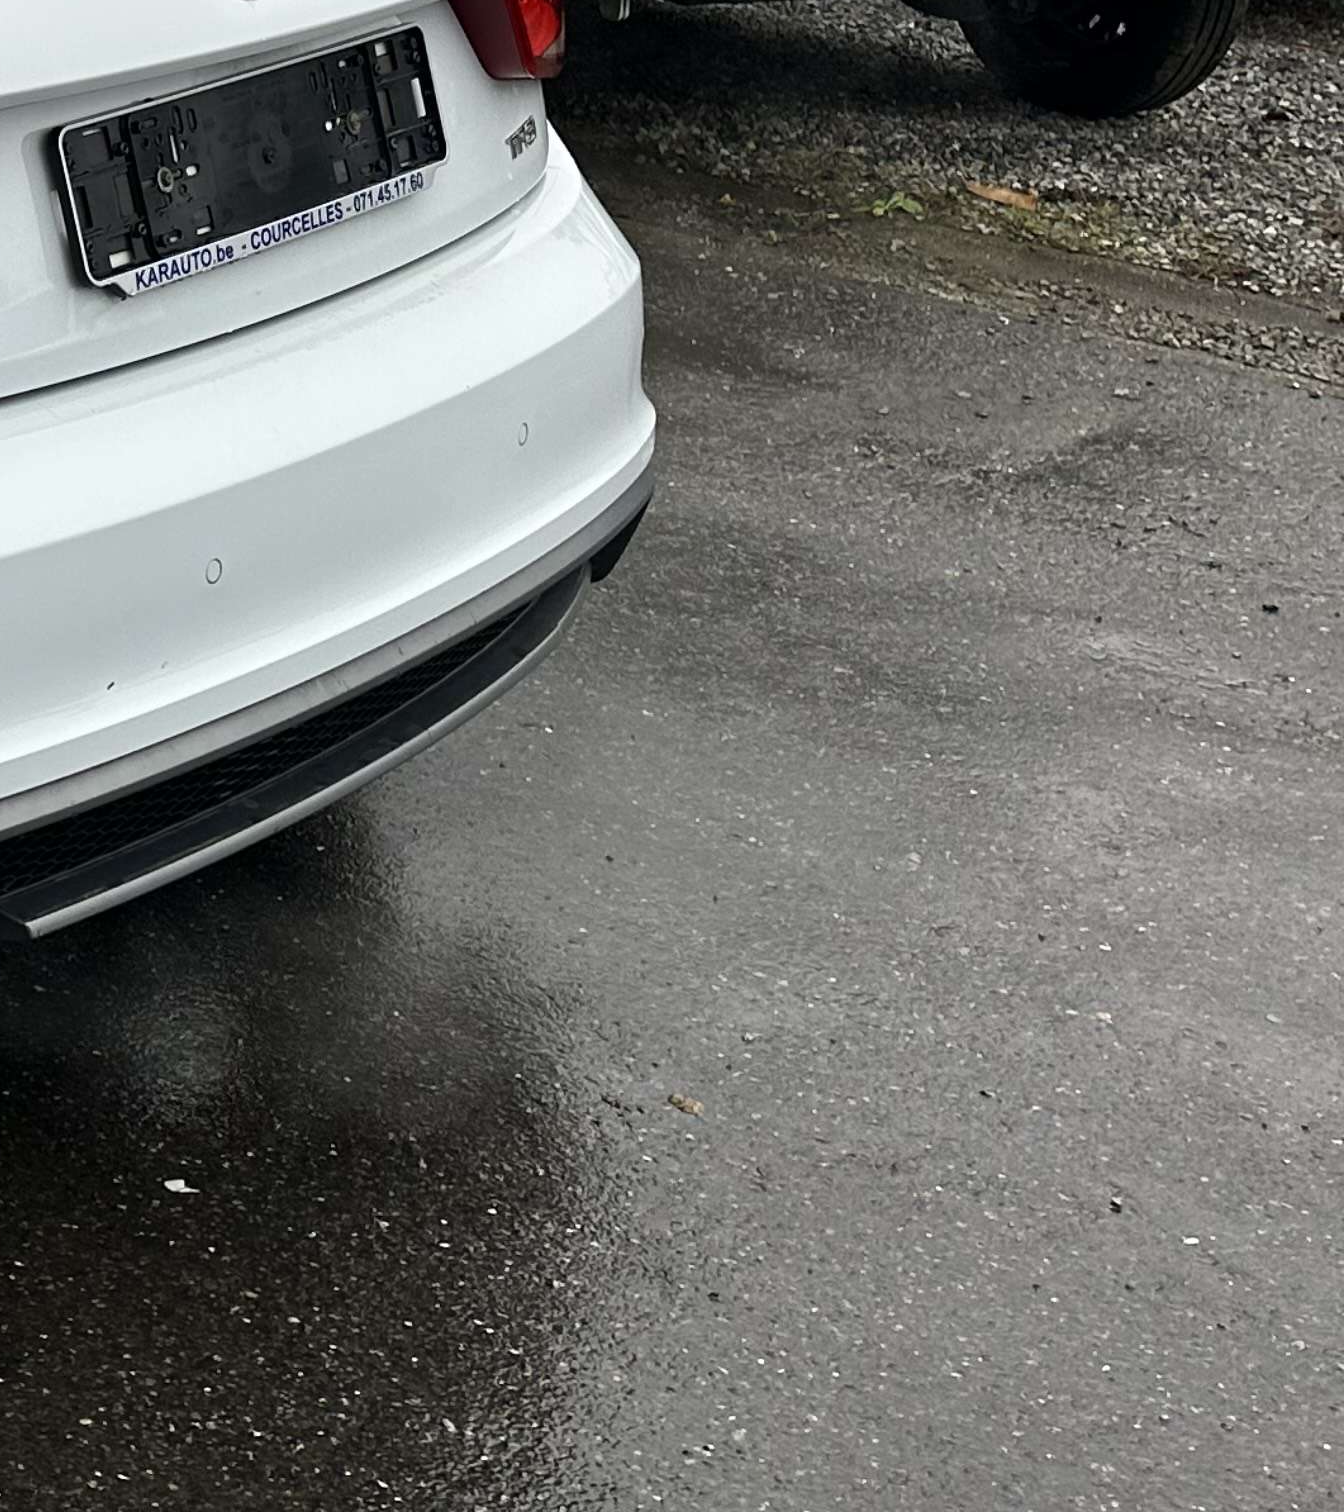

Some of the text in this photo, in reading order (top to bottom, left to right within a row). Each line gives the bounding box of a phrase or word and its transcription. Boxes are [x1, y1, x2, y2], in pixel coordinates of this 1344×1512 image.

[135, 244, 234, 291] KARAUTO.be
[250, 201, 343, 251] COURCELLES
[353, 171, 424, 213] 071.45.17.60
